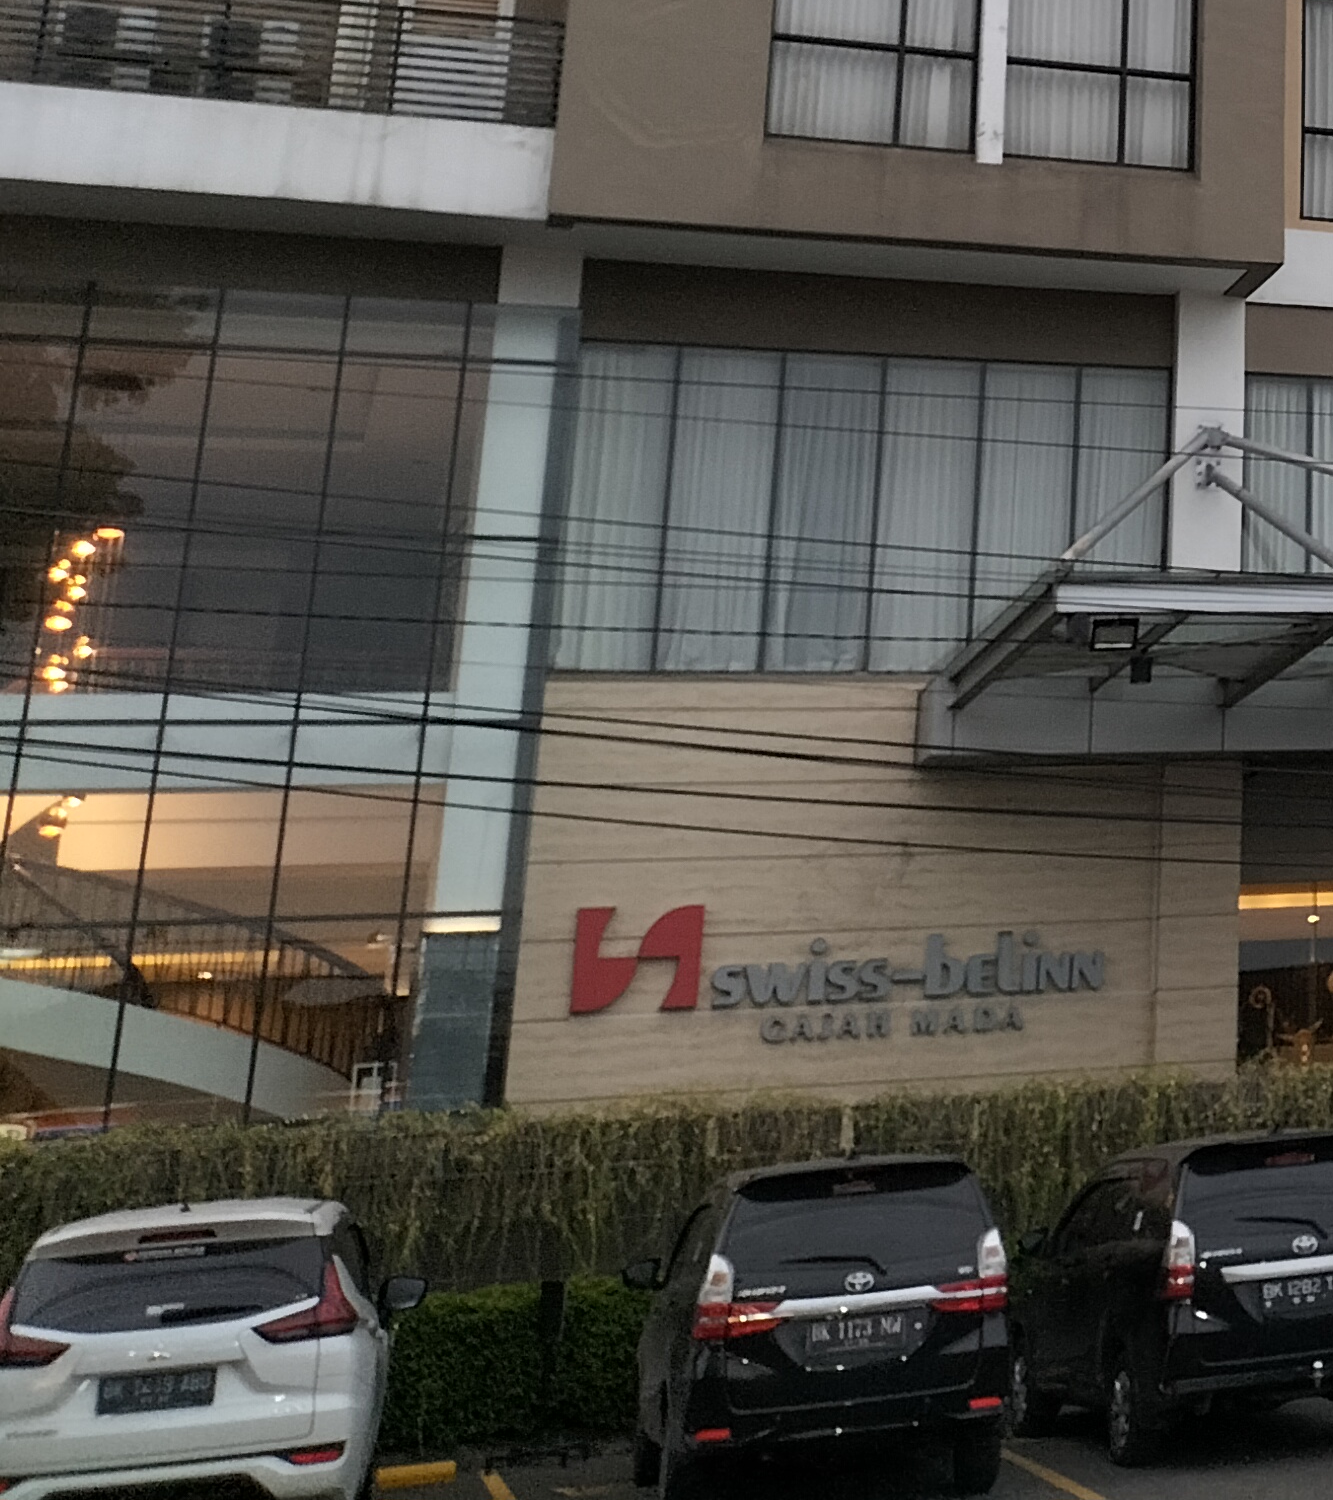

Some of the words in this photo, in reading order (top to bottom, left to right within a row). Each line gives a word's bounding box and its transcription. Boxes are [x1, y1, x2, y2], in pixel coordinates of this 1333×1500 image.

[761, 1008, 892, 1044] GAJAH
[910, 1003, 1024, 1037] MADA
[1262, 1282, 1283, 1299] BK
